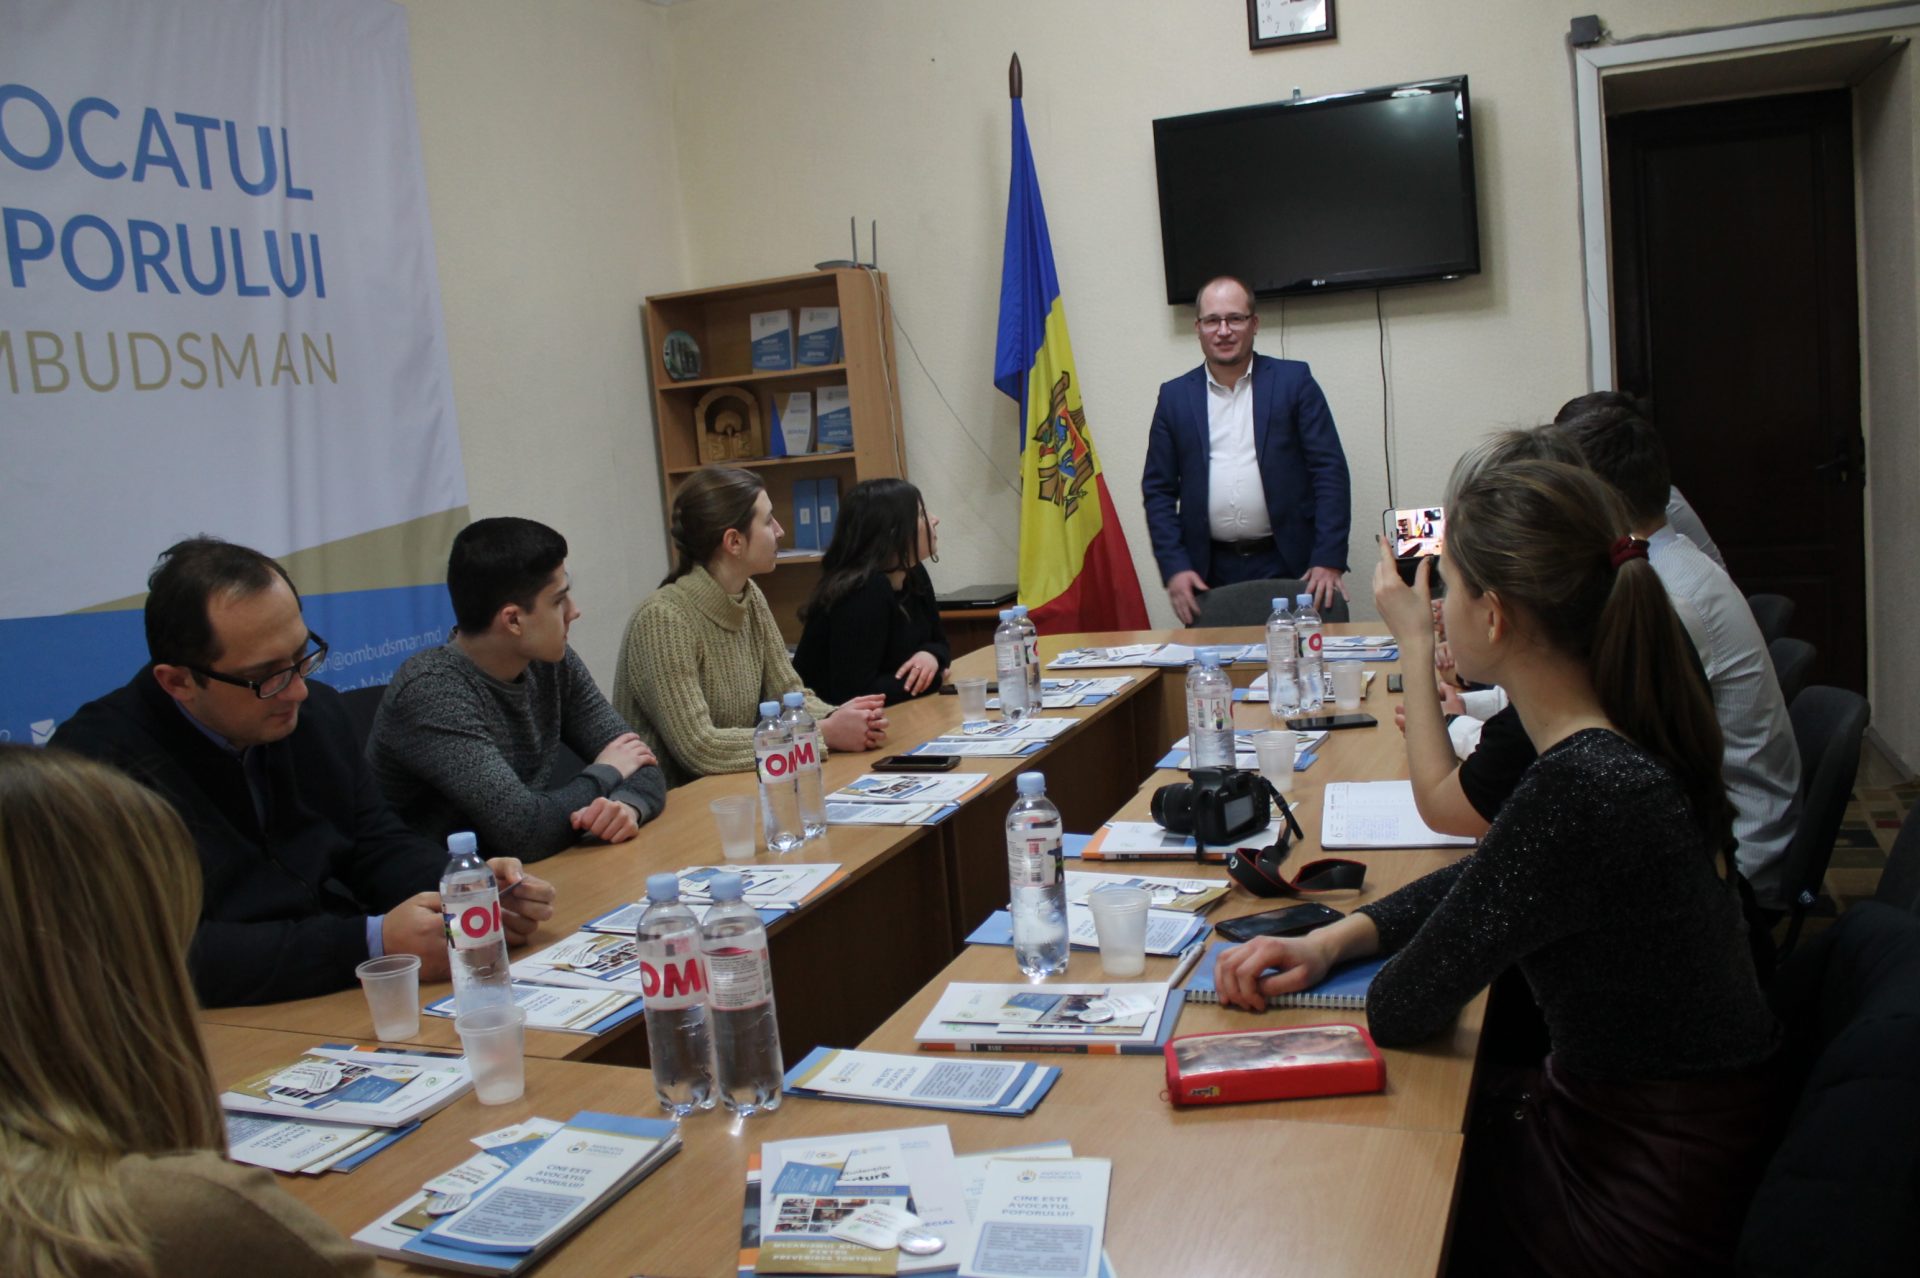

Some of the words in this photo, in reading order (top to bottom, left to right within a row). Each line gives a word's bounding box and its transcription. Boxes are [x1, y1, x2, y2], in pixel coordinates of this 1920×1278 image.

[0, 83, 313, 200] OCATUL
[2, 207, 326, 299] PORULUI
[1008, 1202, 1071, 1210] AVOCATUL
